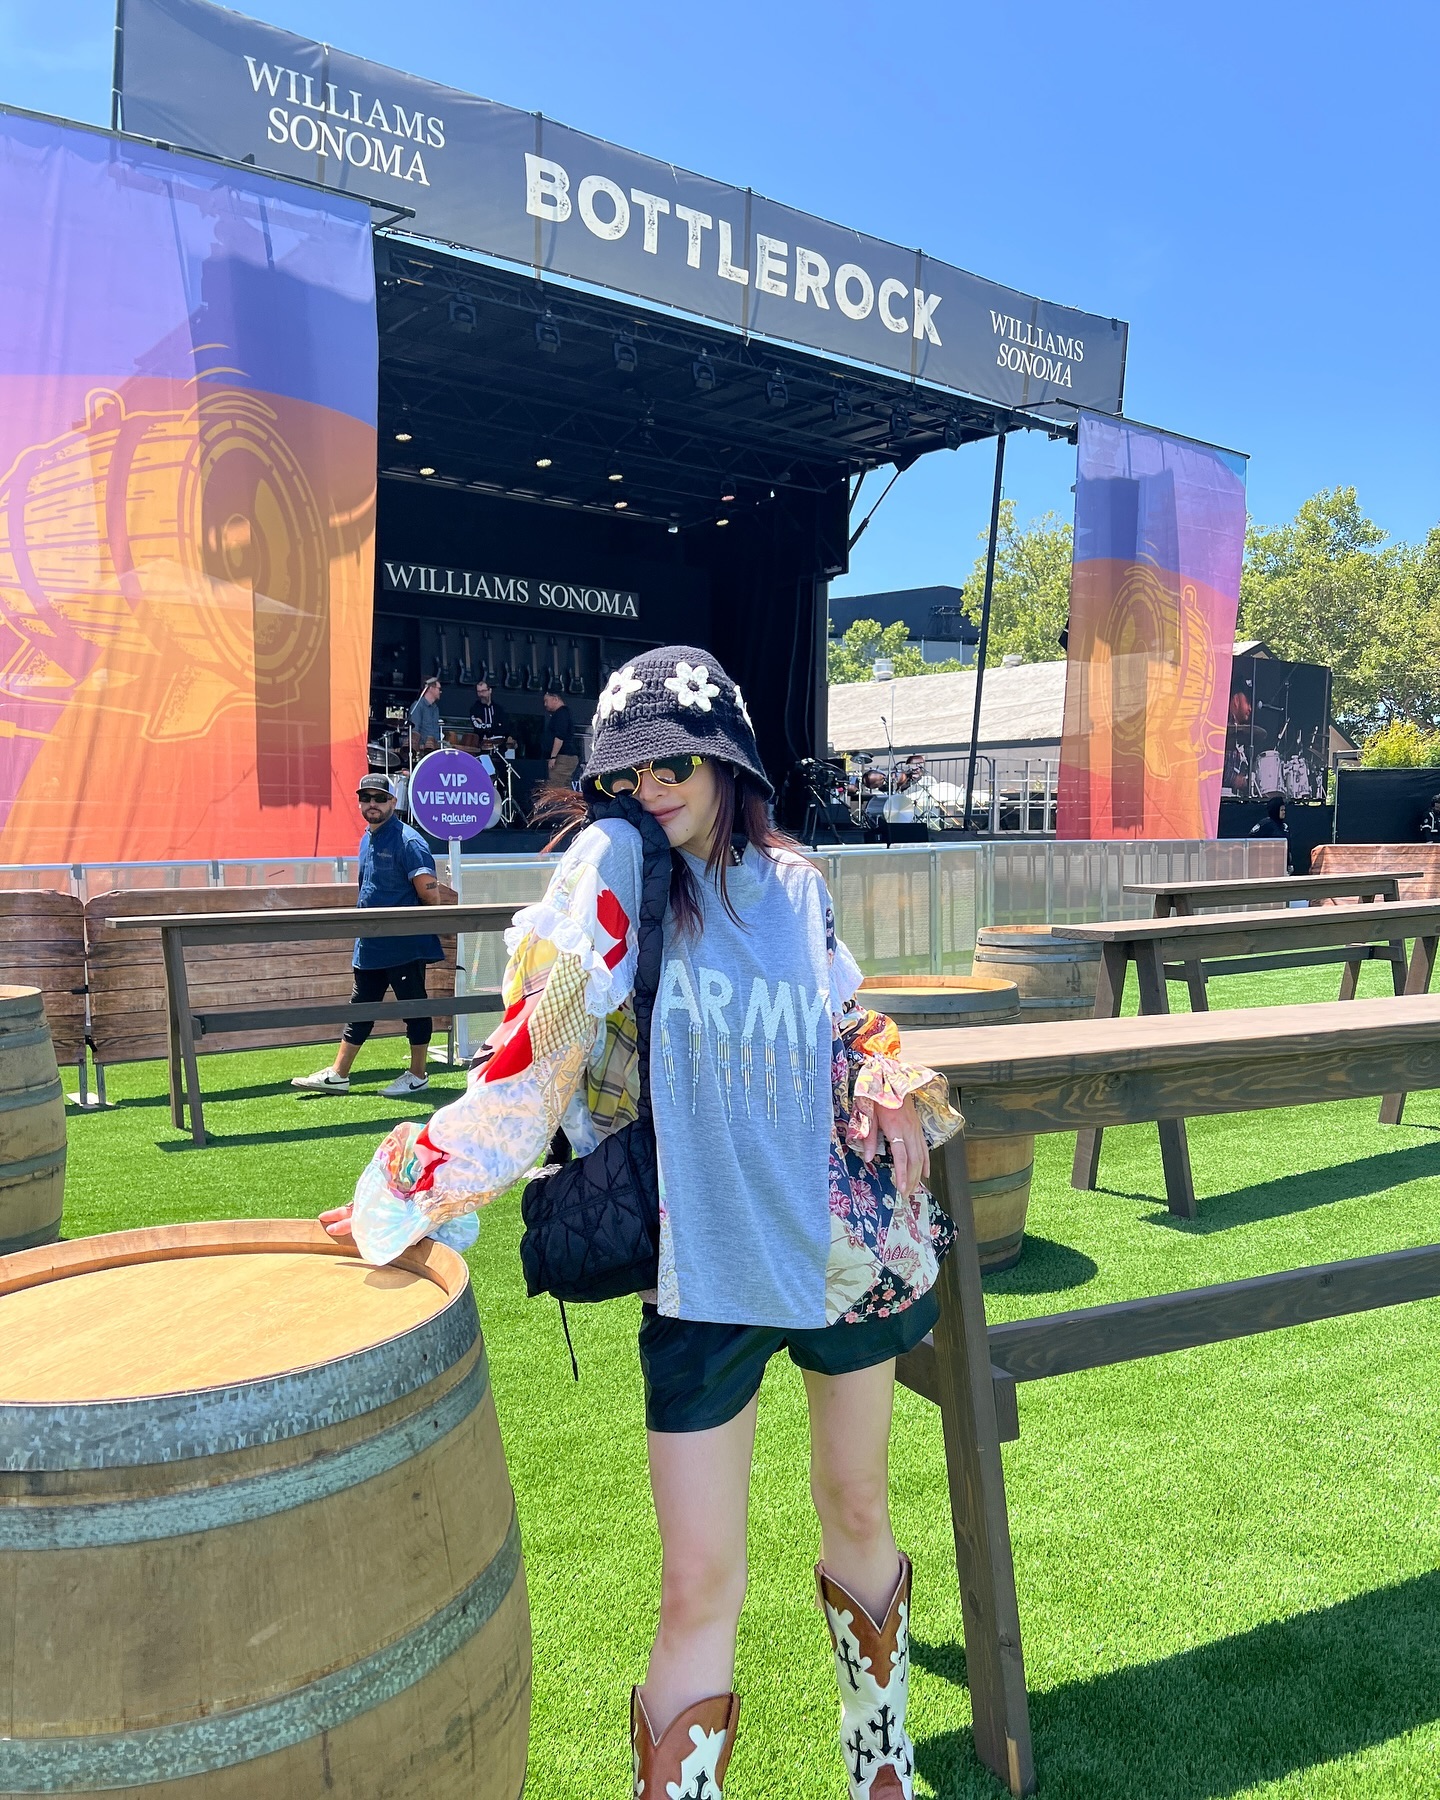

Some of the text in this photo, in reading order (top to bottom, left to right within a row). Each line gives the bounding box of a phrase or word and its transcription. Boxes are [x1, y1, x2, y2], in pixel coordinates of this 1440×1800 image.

[243, 55, 446, 149] WILLIAMS
[267, 107, 431, 186] SONOMA
[524, 152, 943, 347] BOTTLEROCK
[989, 309, 1084, 363] WILLIAMS
[996, 343, 1073, 388] SONOMA
[384, 562, 639, 618] WILLIAMS SONOMA
[416, 790, 491, 806] VIEWING
[439, 773, 468, 787] VIP
[441, 812, 477, 823] Rakuten
[660, 959, 830, 1048] ARMY
